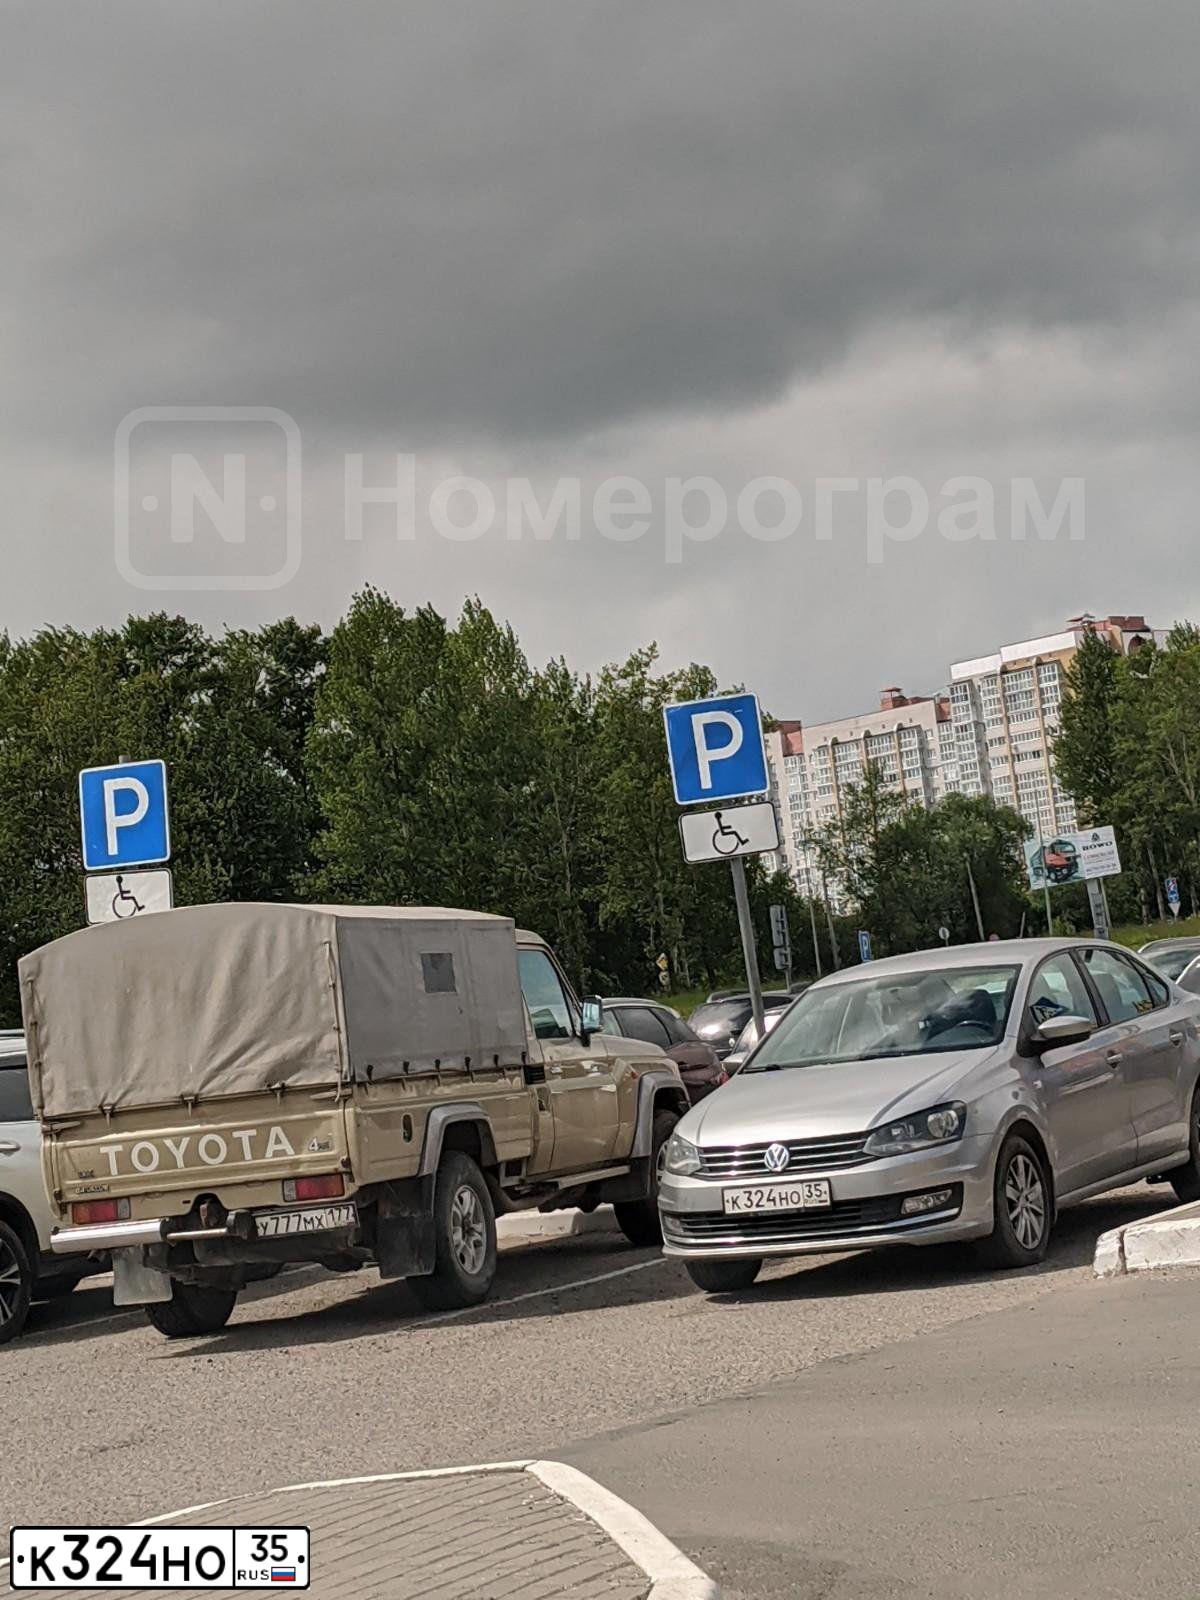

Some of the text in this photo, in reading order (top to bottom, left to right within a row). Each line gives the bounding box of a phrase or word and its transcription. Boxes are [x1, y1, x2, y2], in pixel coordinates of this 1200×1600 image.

[690, 710, 744, 790] P
[103, 776, 150, 857] P
[100, 1126, 296, 1177] TOYOTA
[259, 1206, 350, 1236] У777МХ 177
[730, 1183, 823, 1210] К324НО 35
